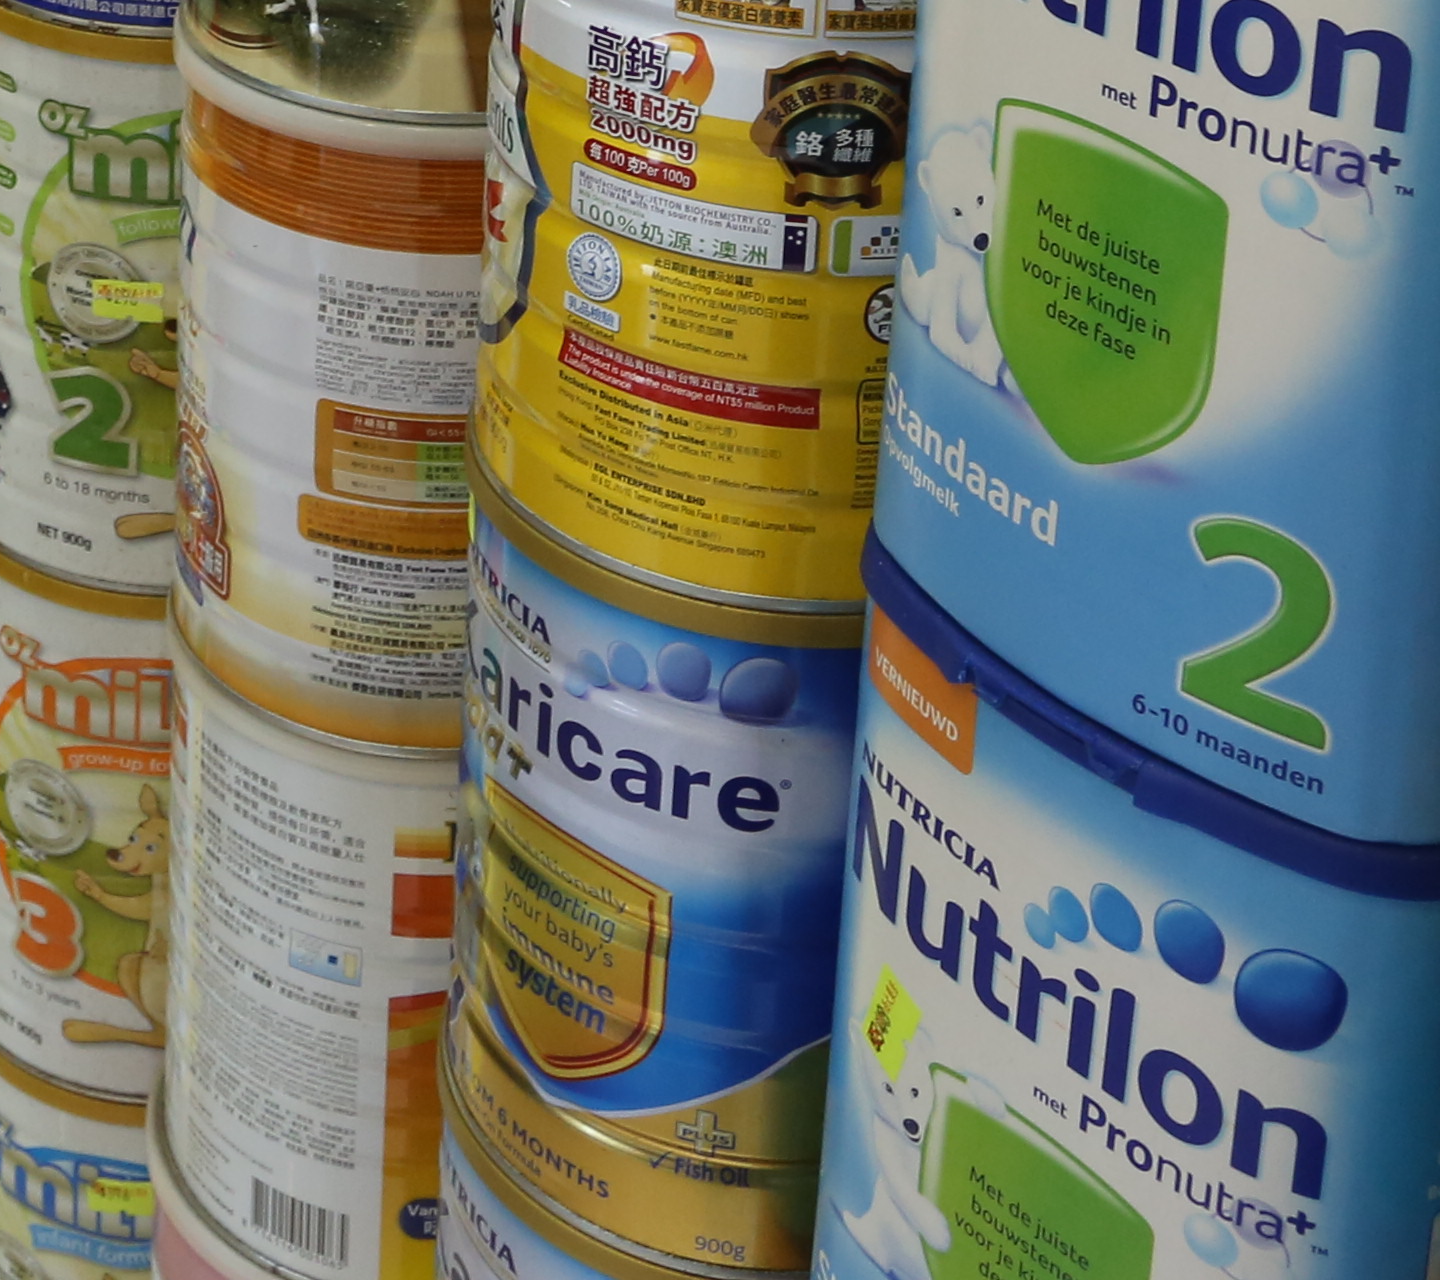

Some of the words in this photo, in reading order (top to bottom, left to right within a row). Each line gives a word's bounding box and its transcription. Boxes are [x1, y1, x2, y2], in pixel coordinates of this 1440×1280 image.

[587, 24, 669, 88] 高鈣
[587, 74, 699, 132] 超強配方
[591, 110, 697, 164] 2000mg
[1100, 79, 1138, 112] met
[1149, 73, 1403, 192] Pronutra+
[1036, 198, 1073, 233] Met
[1077, 214, 1101, 248] de
[1105, 226, 1161, 277] juiste
[1038, 228, 1158, 309] bouwstenen
[1020, 254, 1059, 292] voor
[1063, 270, 1082, 304] je
[1084, 283, 1147, 334] kindje
[1152, 318, 1171, 347] in
[1045, 299, 1088, 335] deze
[1093, 319, 1137, 363] fase
[49, 366, 138, 475] 2
[885, 374, 1060, 549] Standaard
[881, 419, 961, 520] Opvolgmelk
[1179, 513, 1336, 753] 2
[873, 643, 959, 745] VERNIEUWD
[67, 749, 139, 772] grow-up
[1130, 691, 1190, 739] 6-10
[1196, 728, 1325, 797] maanden
[861, 737, 1001, 892] NUTRICIA
[13, 875, 82, 975] 3
[503, 887, 542, 926] your
[546, 913, 614, 968] baby's
[505, 821, 616, 944] supporting
[502, 907, 614, 1006] immune
[505, 949, 606, 1035] system
[852, 770, 1331, 1204] Nutrilon
[512, 1119, 610, 1199] MONTHS
[674, 1157, 714, 1182] Fish
[720, 1165, 749, 1188] Oil
[1032, 1082, 1069, 1121] met
[1079, 1093, 1317, 1248] Pronutra+
[695, 1236, 745, 1262] 900g
